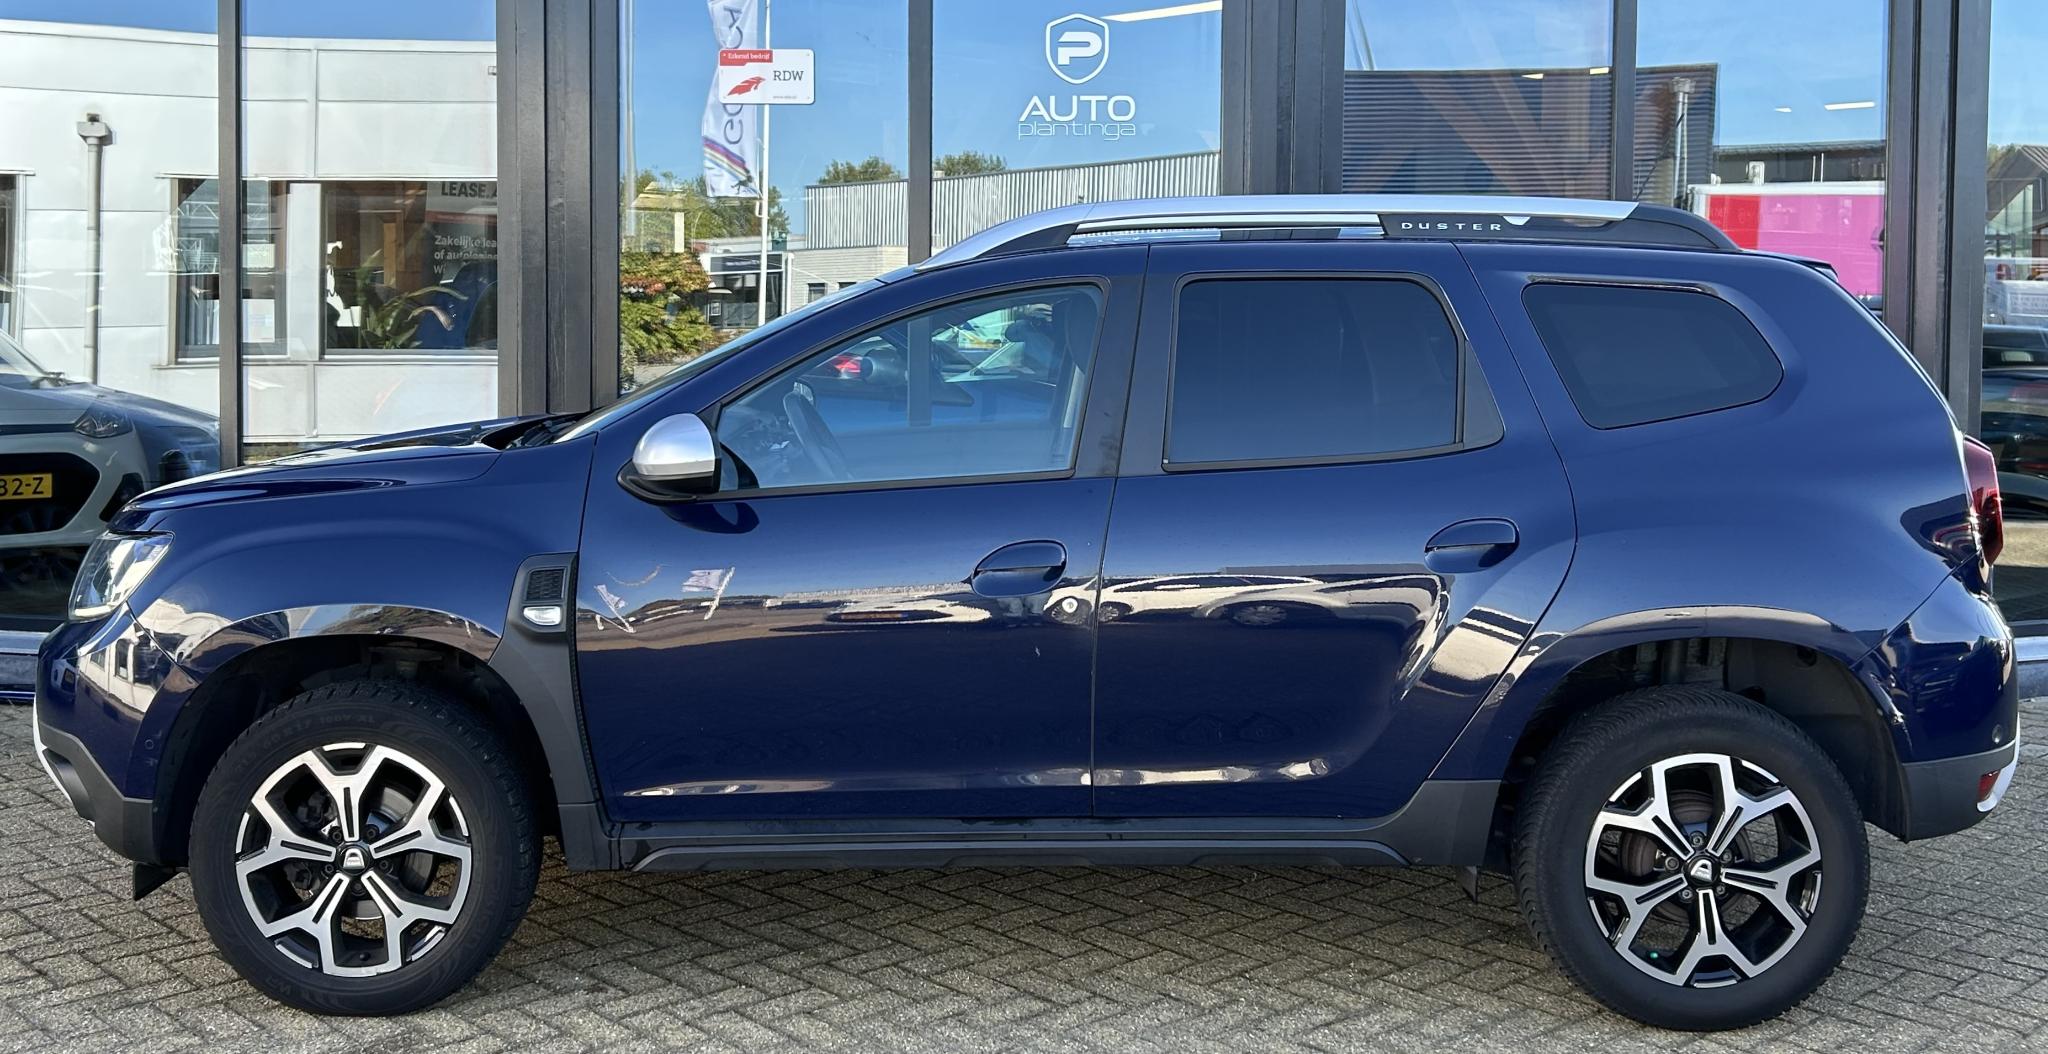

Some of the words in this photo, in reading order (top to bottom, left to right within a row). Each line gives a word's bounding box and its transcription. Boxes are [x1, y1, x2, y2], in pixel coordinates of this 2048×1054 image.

[773, 70, 804, 81] RDW
[1018, 95, 1136, 122] AUTO
[1018, 121, 1136, 141] plantinga
[1401, 222, 1501, 231] DUSTER
[434, 235, 481, 249] Zakelijke
[482, 236, 498, 249] lea
[434, 249, 445, 260] of
